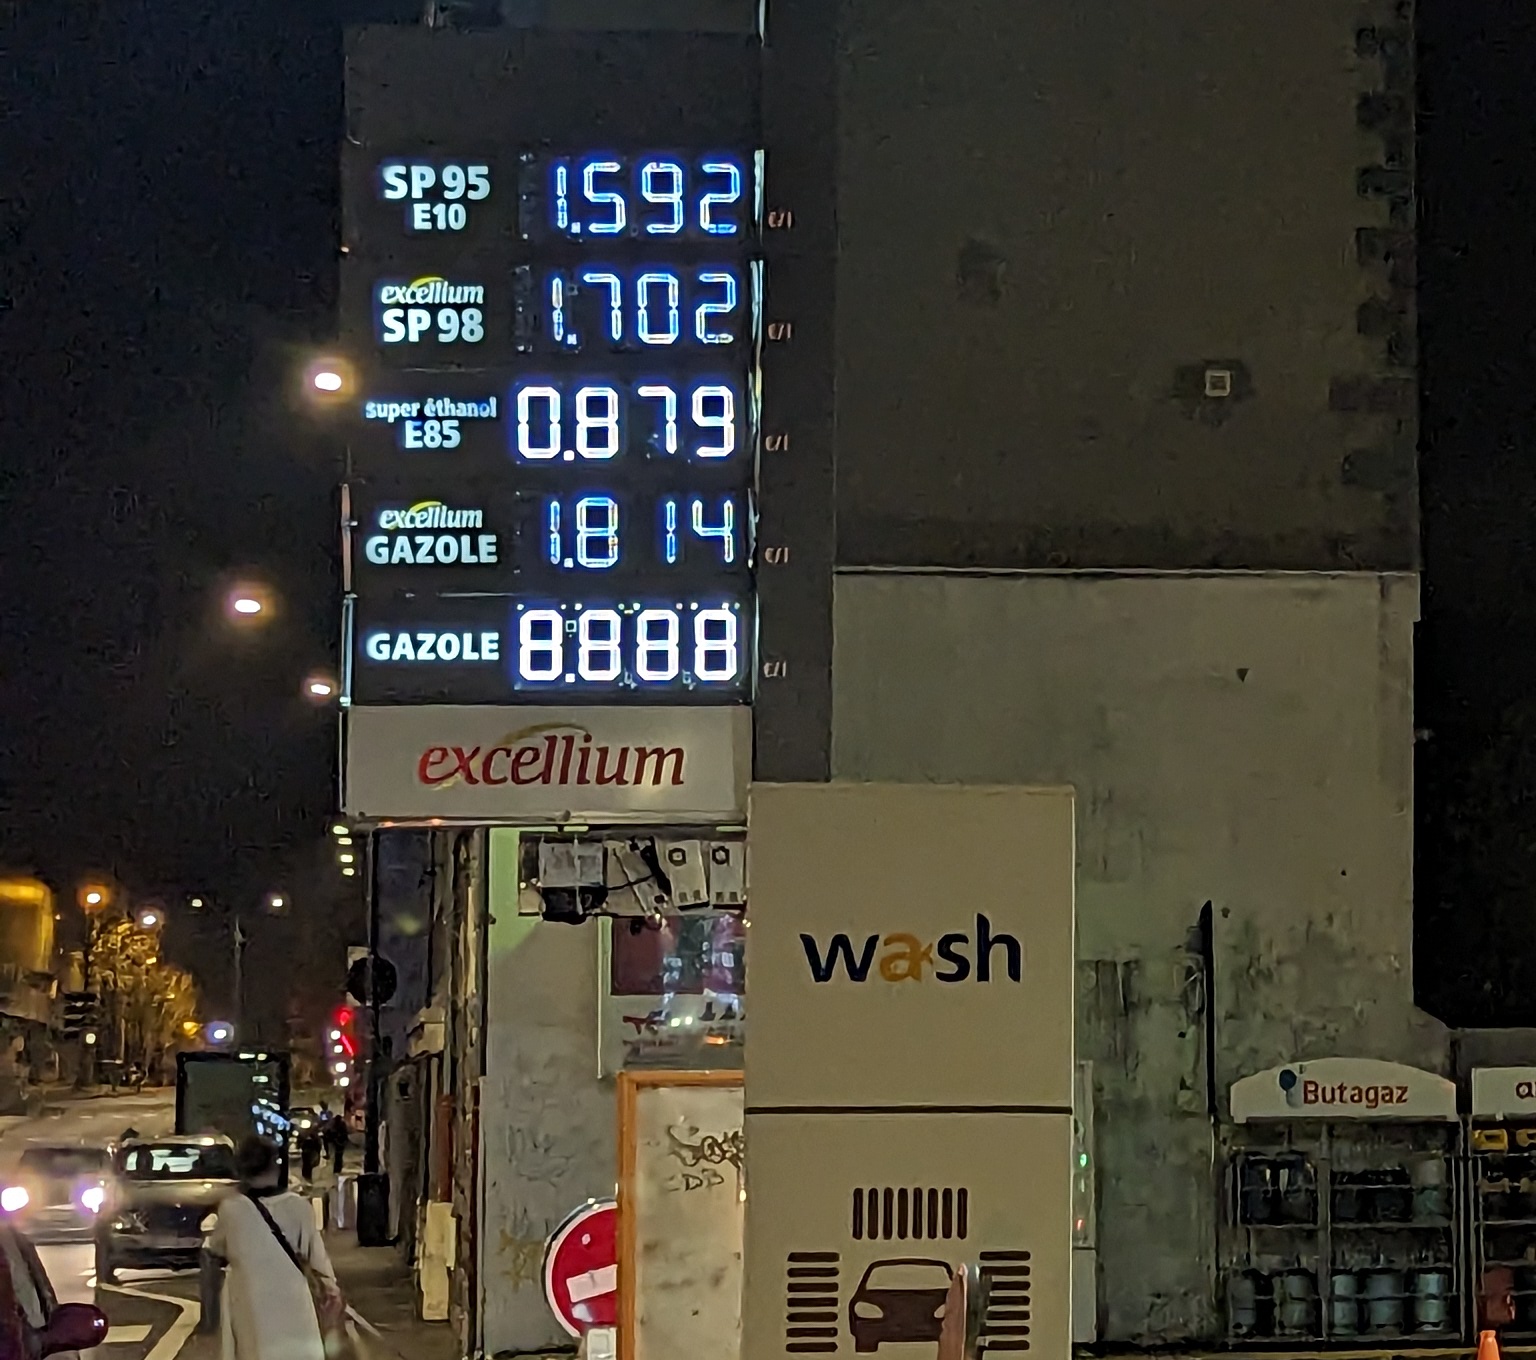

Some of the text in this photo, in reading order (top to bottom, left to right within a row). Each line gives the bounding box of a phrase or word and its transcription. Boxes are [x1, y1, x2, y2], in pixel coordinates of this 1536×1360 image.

[413, 203, 467, 231] E10
[380, 278, 485, 305] excellium
[365, 401, 421, 424] super
[517, 385, 735, 461] 0.879
[404, 419, 461, 449] E85
[378, 502, 483, 529] excellium
[365, 534, 498, 565] GAZOLE
[366, 631, 500, 661] GAZOLE
[417, 732, 686, 787] excellium
[799, 911, 1022, 984] wash
[1302, 1079, 1409, 1110] Butagaz
